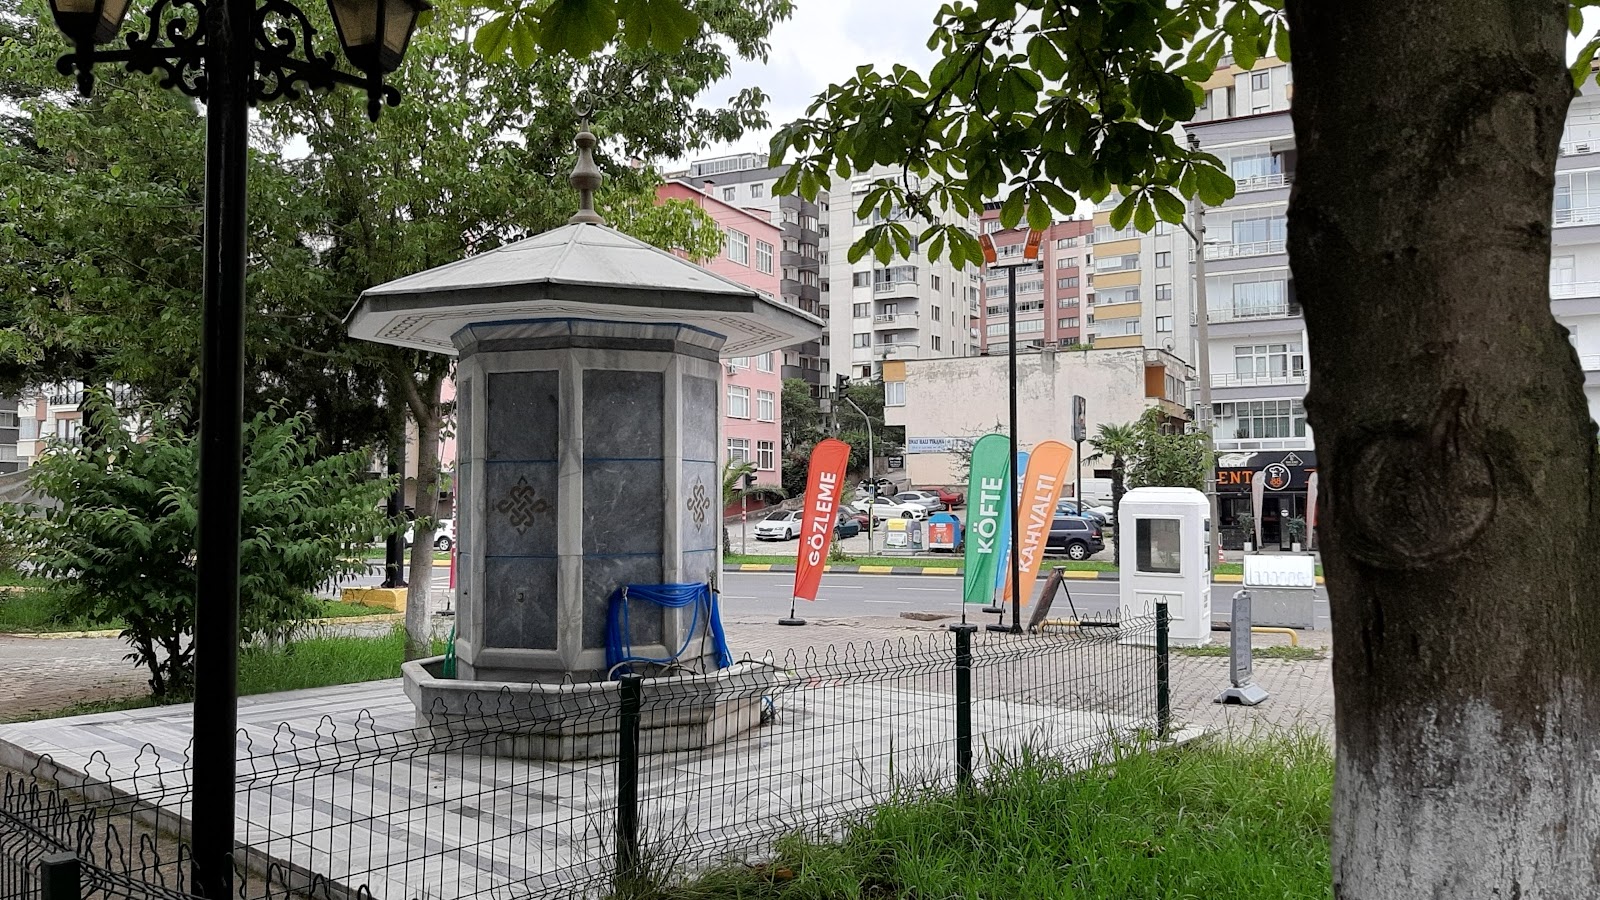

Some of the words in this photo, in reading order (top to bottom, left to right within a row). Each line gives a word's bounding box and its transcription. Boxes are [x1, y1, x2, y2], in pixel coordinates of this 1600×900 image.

[807, 471, 837, 567] GÖZLEME
[972, 477, 1003, 554] KÖFTE
[1018, 474, 1057, 574] KAHVALTI
